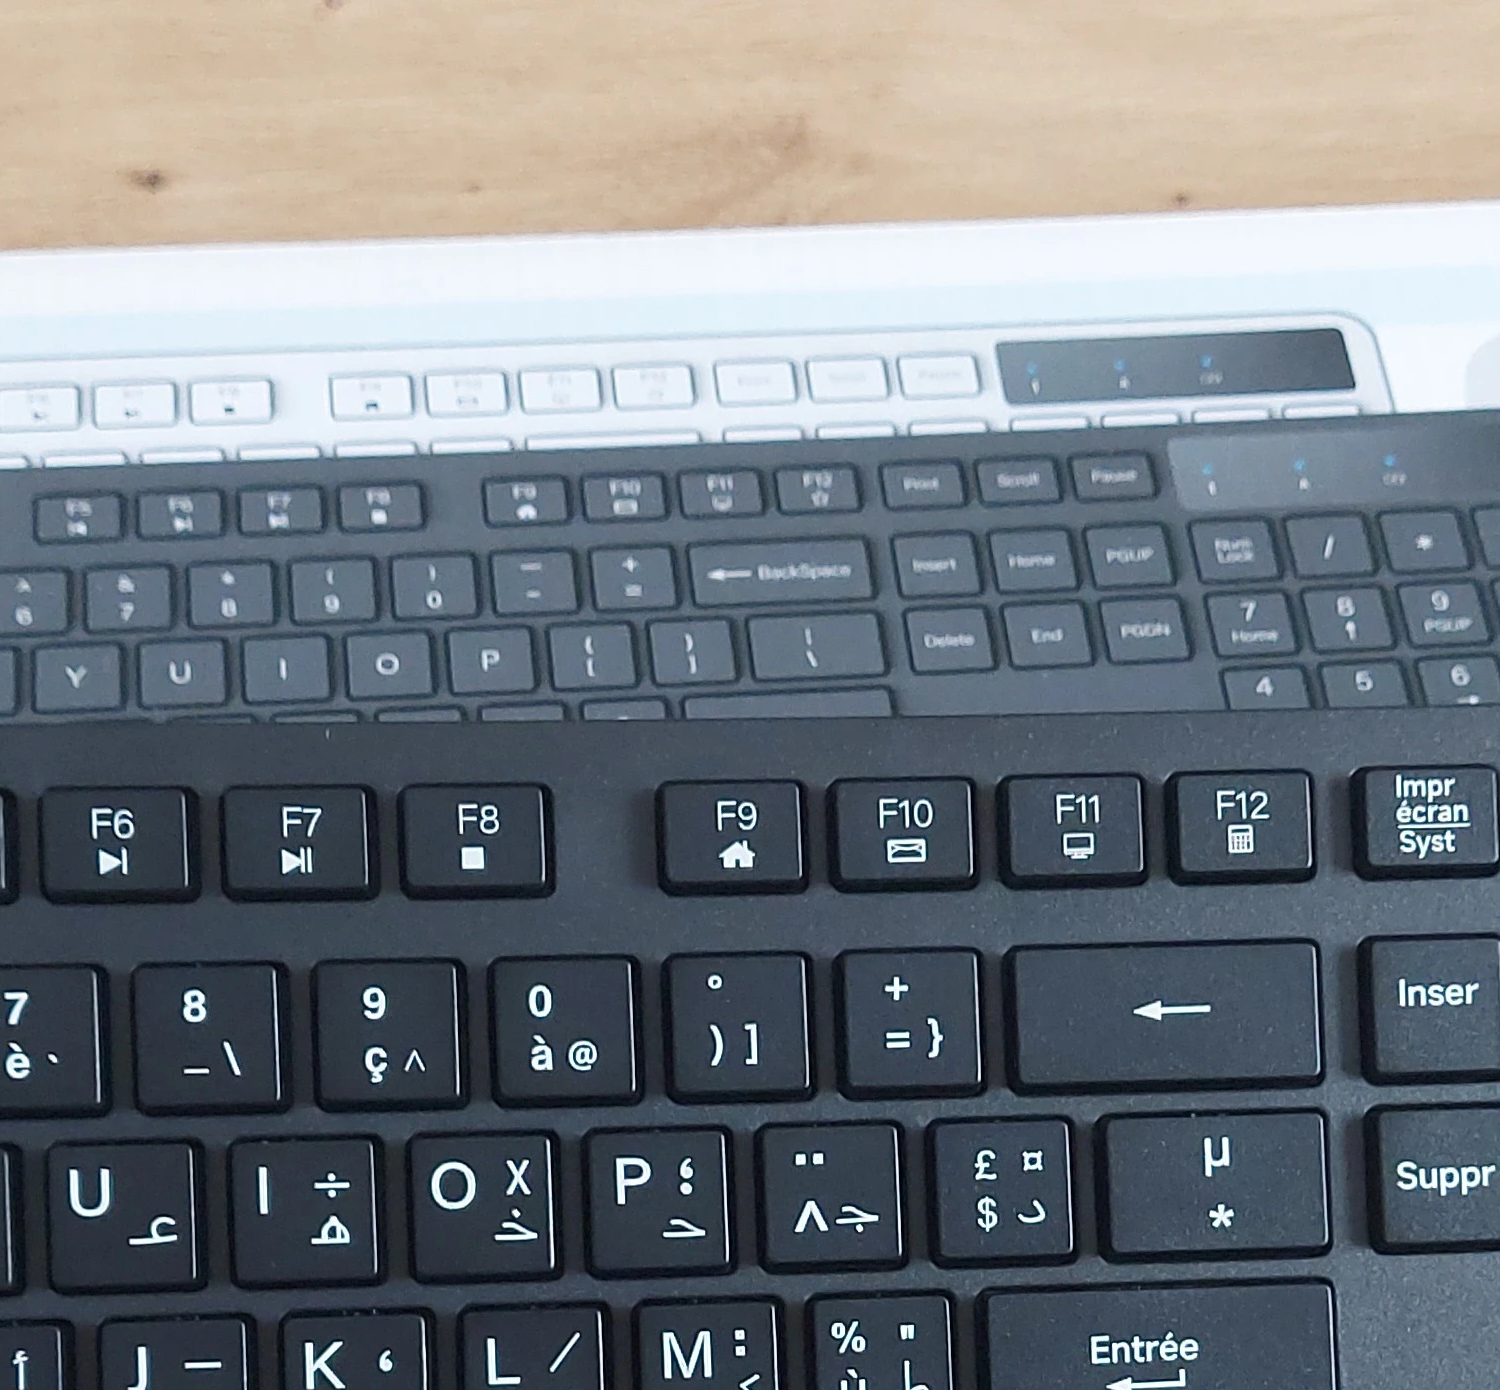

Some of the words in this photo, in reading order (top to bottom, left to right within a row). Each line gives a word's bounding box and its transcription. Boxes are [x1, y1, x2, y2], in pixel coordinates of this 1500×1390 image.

[1239, 600, 1257, 622] 7
[169, 661, 193, 685] U
[374, 653, 400, 676] O
[480, 649, 500, 673] P
[1450, 663, 1471, 686] 6
[64, 666, 88, 689] Y
[1256, 675, 1275, 697] 4
[1396, 774, 1456, 800] Impr
[458, 803, 500, 835] F8
[717, 800, 757, 832] F9
[878, 798, 933, 829] F10
[1056, 793, 1100, 825] F11
[1216, 790, 1270, 821] F12
[1396, 800, 1469, 824] écran
[91, 808, 135, 840] F6
[282, 806, 322, 838] F7
[1399, 829, 1456, 860] Syst
[3, 991, 29, 1025] 7
[182, 989, 207, 1023] 8
[362, 987, 386, 1020] 9
[528, 984, 552, 1018] 0
[1398, 978, 1480, 1007] Inser
[69, 1168, 110, 1217] U
[258, 1166, 269, 1215] I
[431, 1161, 477, 1210] O
[615, 1157, 652, 1205] P
[1396, 1161, 1496, 1197] Suppr
[486, 1337, 521, 1385] L
[662, 1330, 713, 1379] M
[1090, 1331, 1199, 1365] Entrée
[304, 1341, 346, 1390] K
